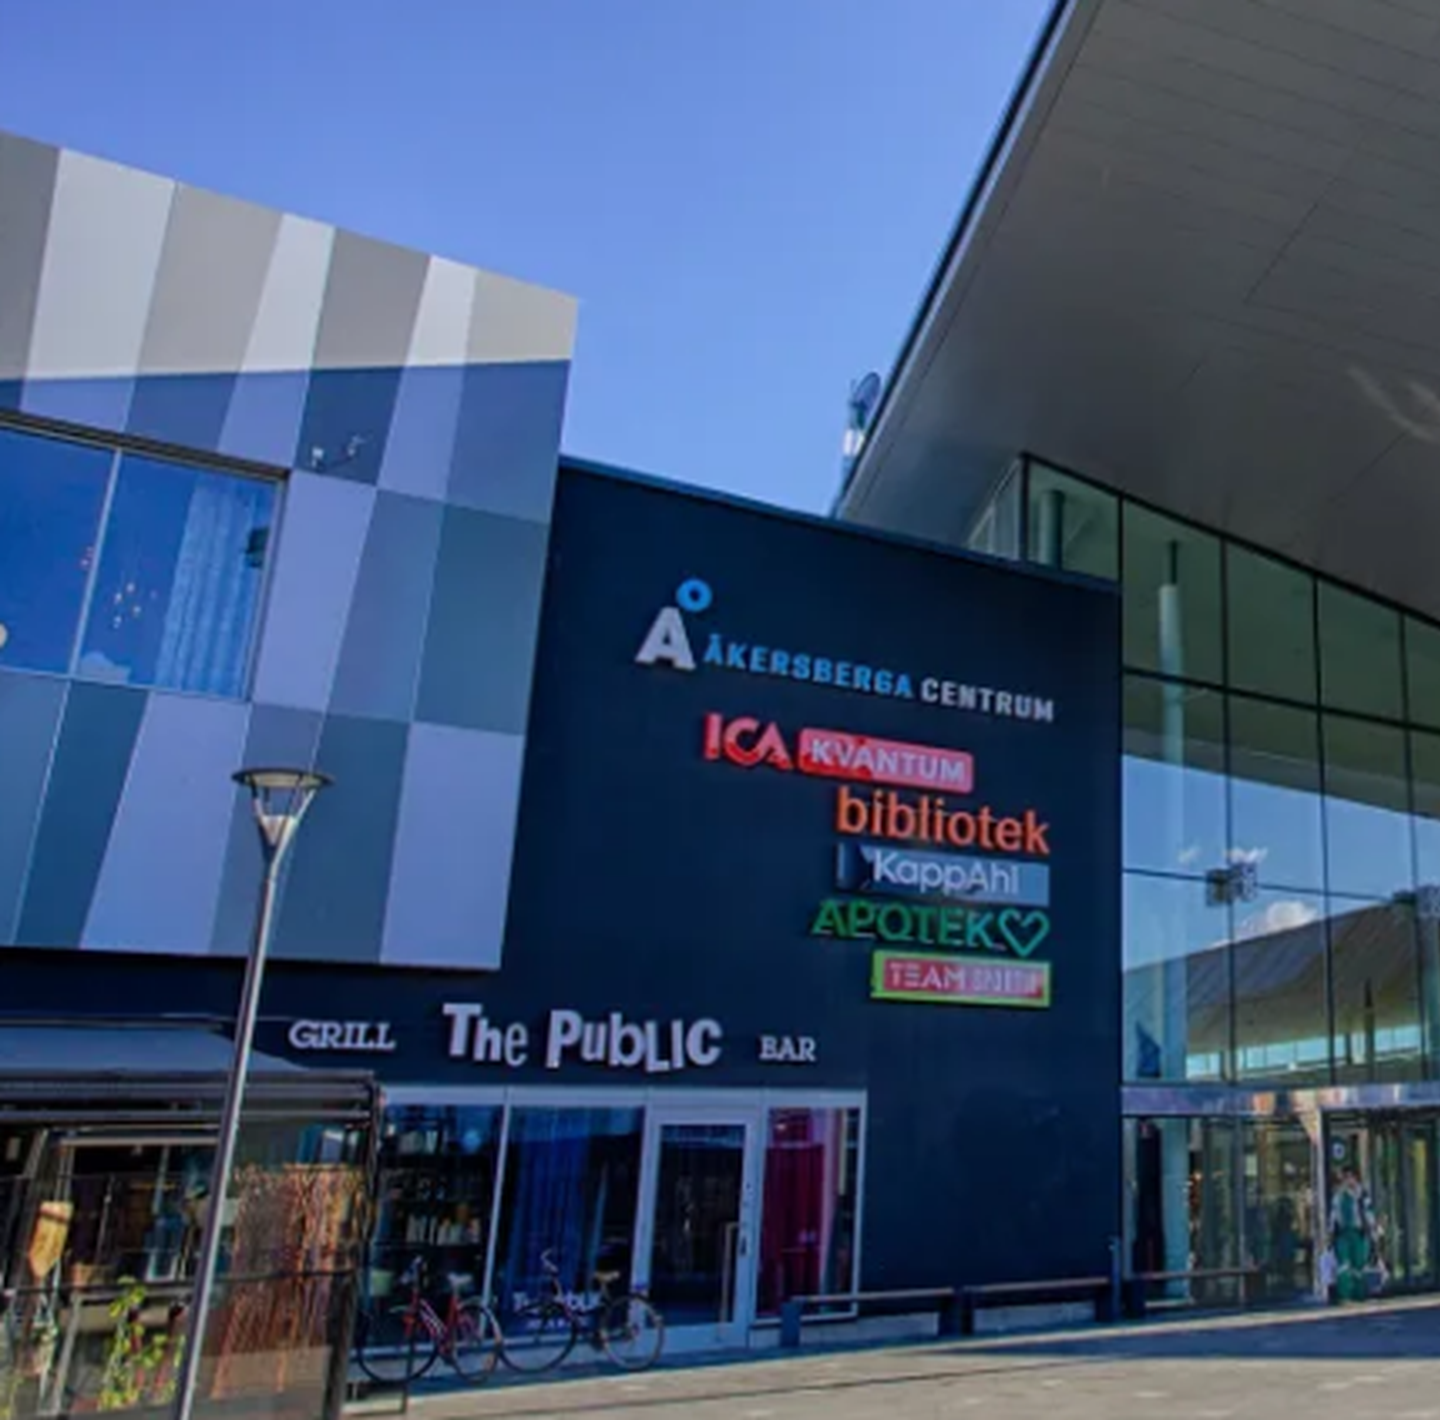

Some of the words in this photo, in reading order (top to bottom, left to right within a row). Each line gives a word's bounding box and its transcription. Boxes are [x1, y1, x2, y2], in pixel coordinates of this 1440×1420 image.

[703, 633, 914, 698] ÅKERSBERGA
[920, 677, 1055, 722] CENTRUM
[704, 712, 794, 770] ICA
[810, 738, 966, 782] KVANTUM
[836, 785, 1051, 854] bibliotek
[873, 848, 1019, 895] KappAhl
[811, 898, 1002, 949] APOTEK
[888, 961, 966, 991] TEAM
[289, 1019, 397, 1050] GRILL
[443, 1002, 528, 1067] The
[759, 1035, 816, 1062] BAR
